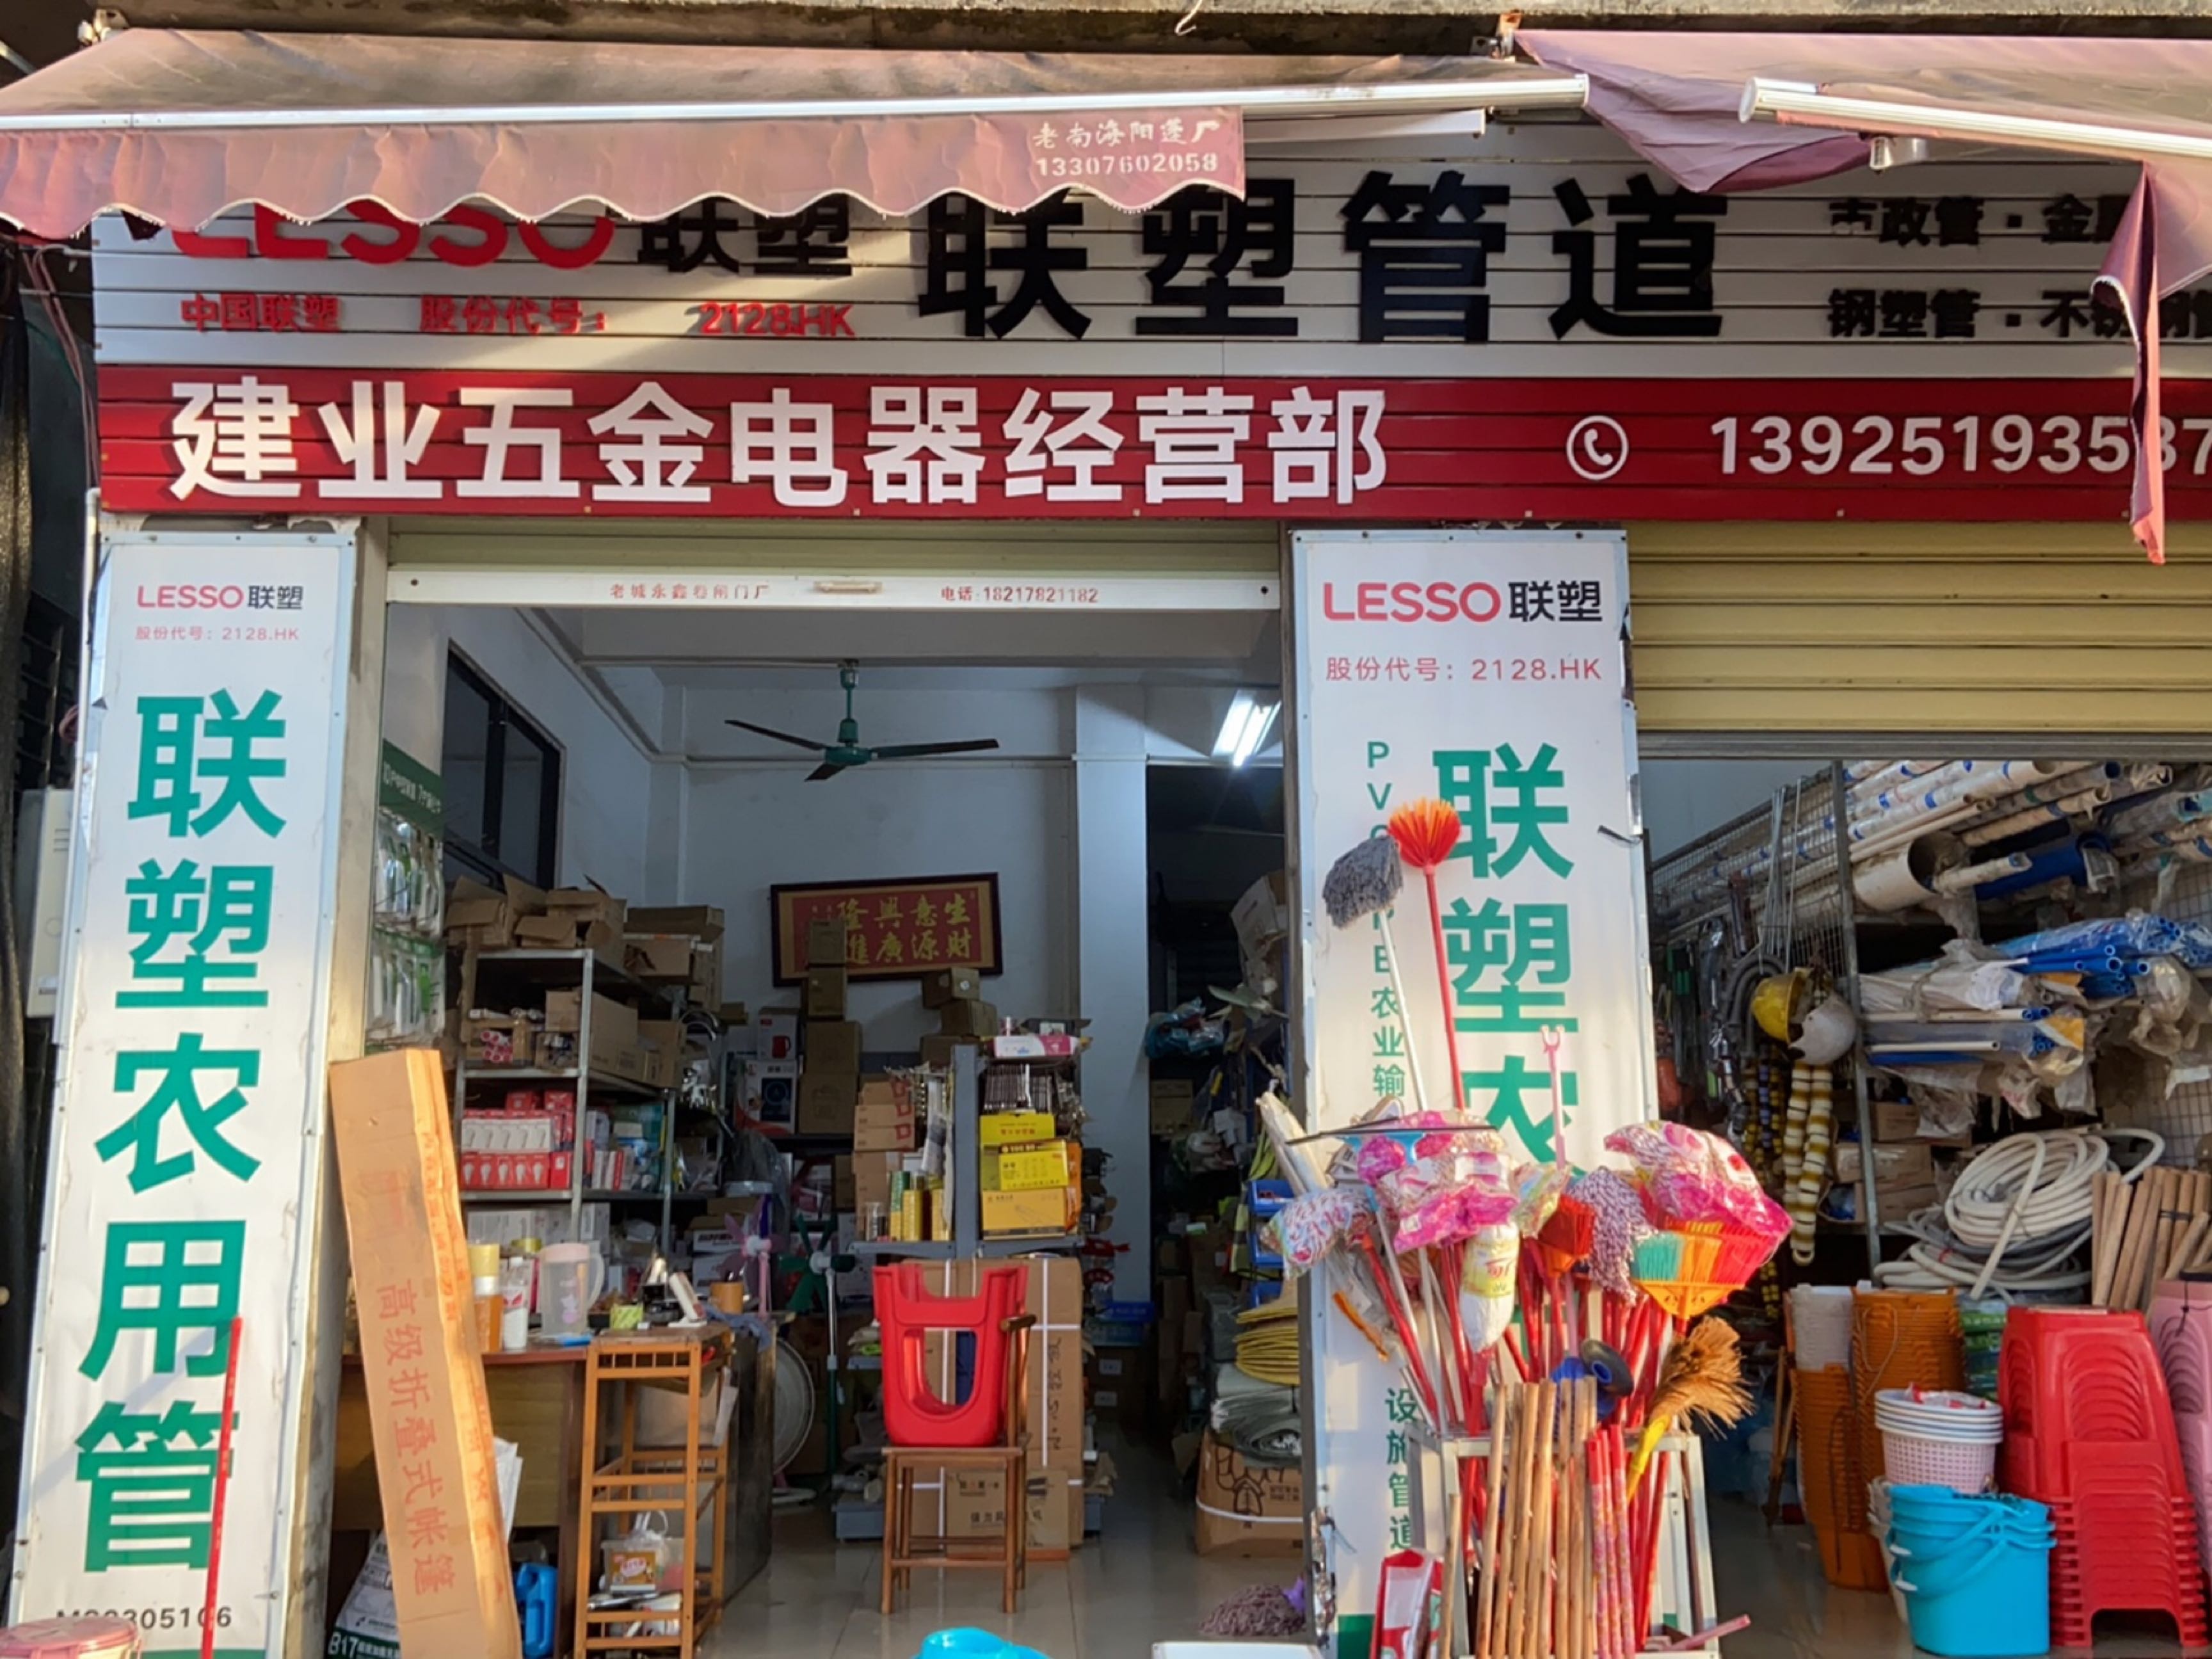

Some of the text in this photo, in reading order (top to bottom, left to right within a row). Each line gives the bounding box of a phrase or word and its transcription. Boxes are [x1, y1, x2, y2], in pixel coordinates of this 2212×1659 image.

[1036, 153, 1219, 176] 13307602058
[919, 170, 1728, 344] 联塑管道
[180, 291, 341, 333] 中国联塑
[169, 376, 1386, 508] 建业五金电器经营部
[136, 584, 303, 611] LESSO 联塑
[1323, 580, 1603, 623] LESSO 联塑
[75, 688, 287, 1572] 联塑农用管
